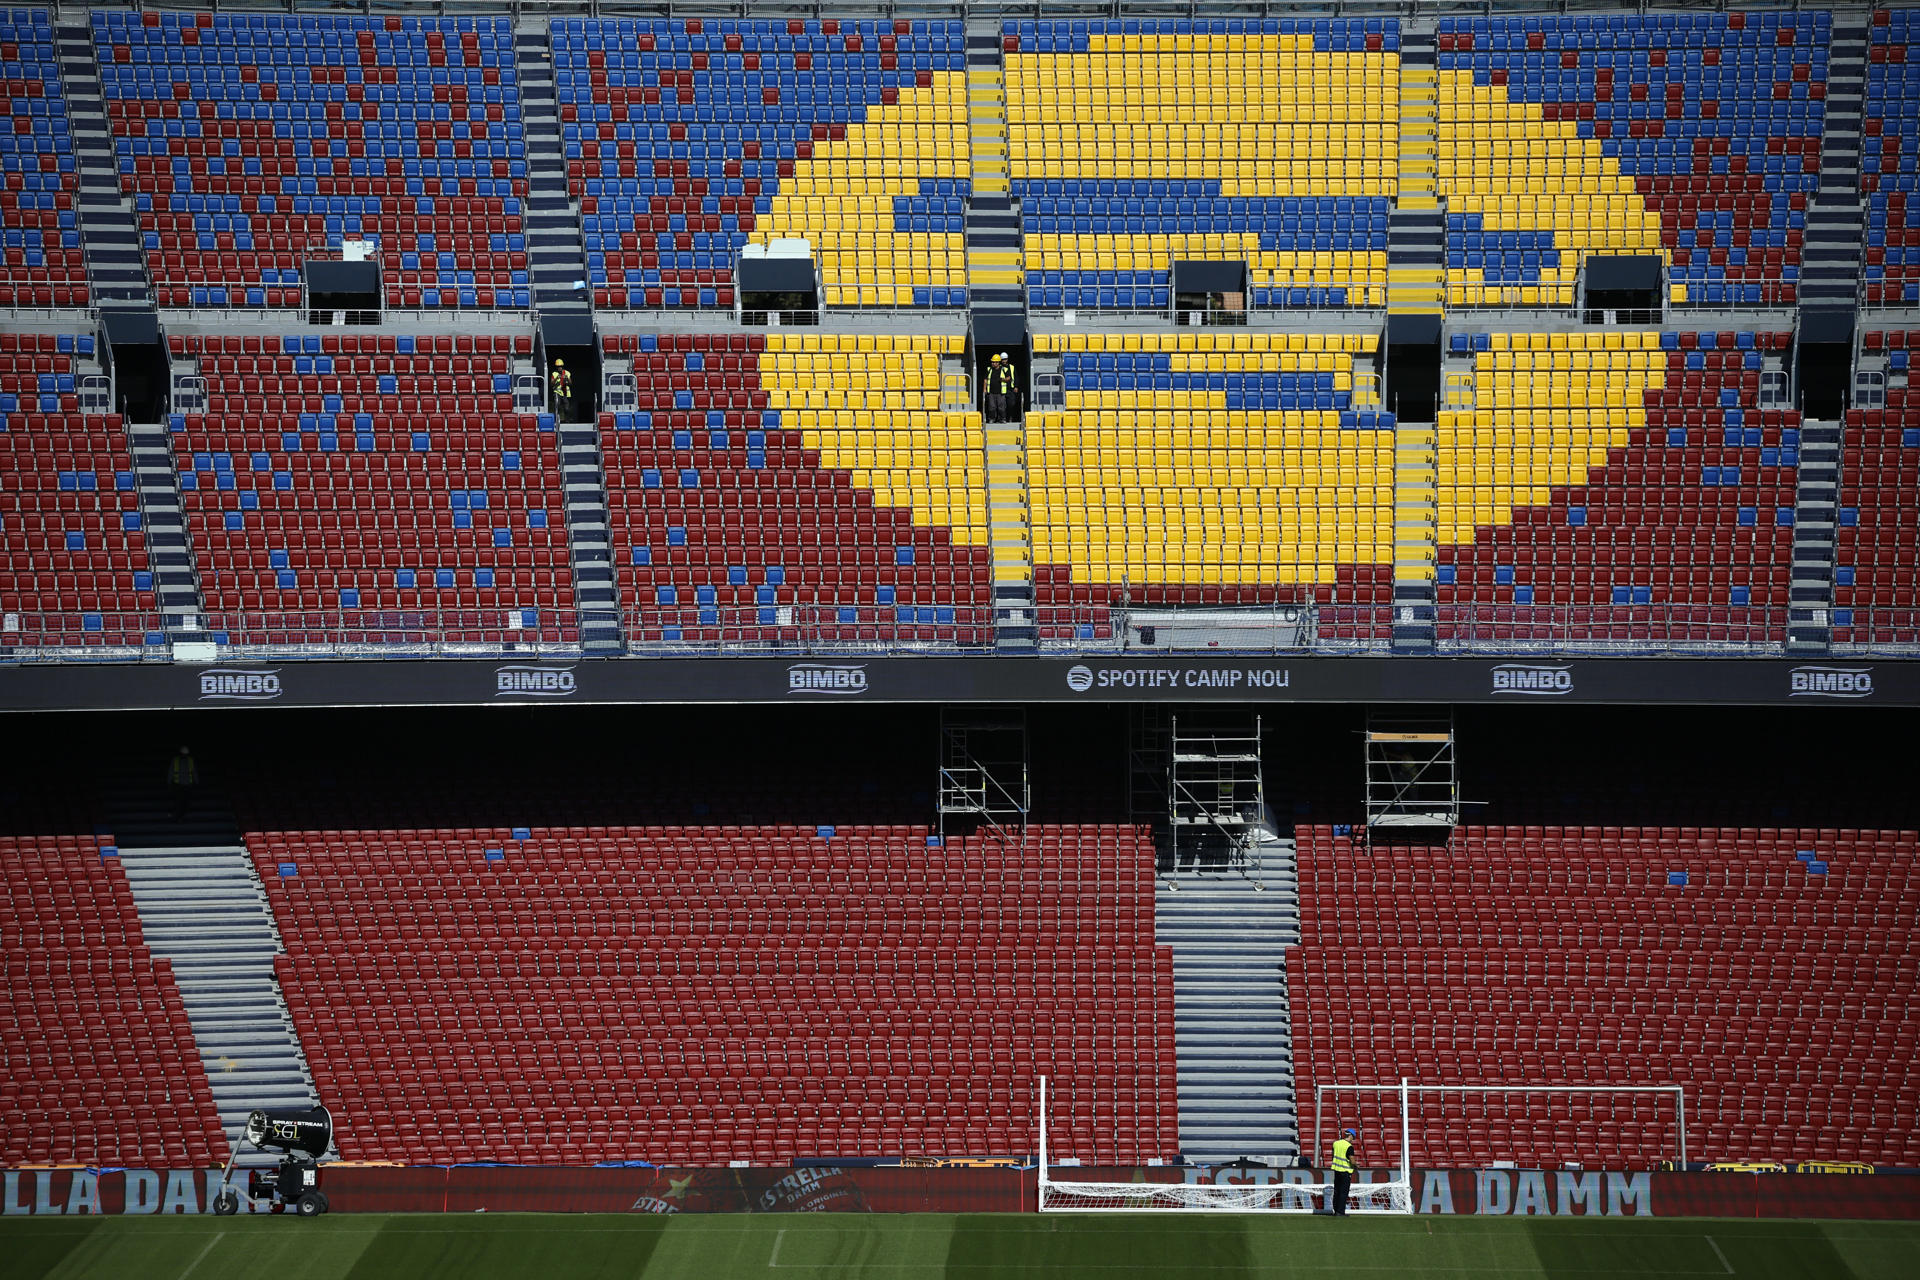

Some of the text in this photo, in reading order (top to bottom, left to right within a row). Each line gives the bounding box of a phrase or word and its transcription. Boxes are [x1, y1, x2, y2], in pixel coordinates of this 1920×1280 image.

[201, 675, 280, 693] BIMBO
[498, 672, 575, 690] BIMBO
[789, 670, 866, 688] BIMBO
[1098, 669, 1289, 687] SPOTIFY CAMP NOU
[1493, 670, 1571, 689] BIMBO
[1791, 673, 1872, 691] BIMBO
[1474, 1171, 1655, 1216] DAMM
